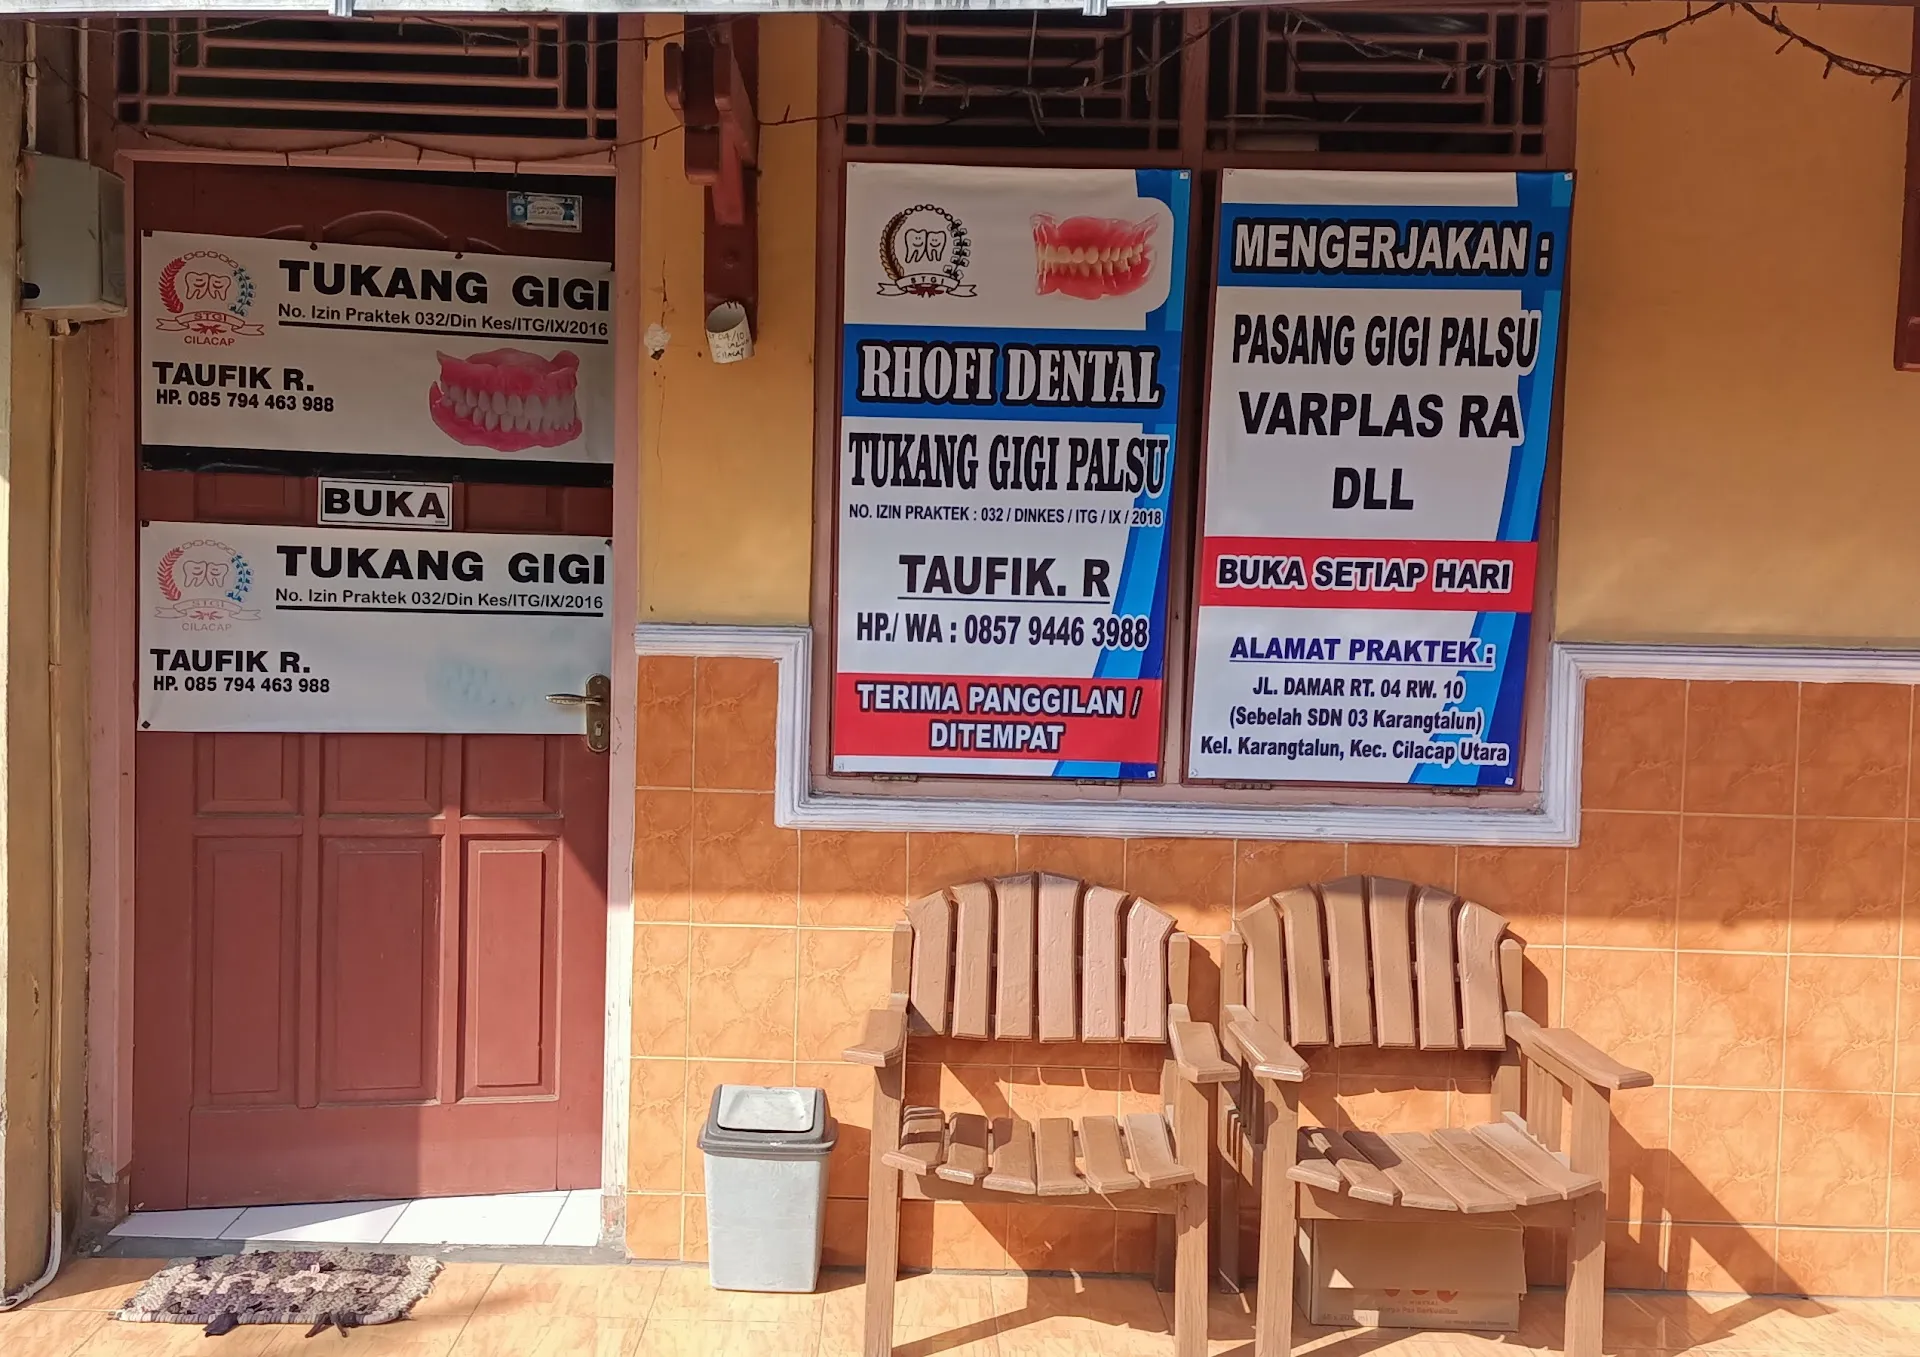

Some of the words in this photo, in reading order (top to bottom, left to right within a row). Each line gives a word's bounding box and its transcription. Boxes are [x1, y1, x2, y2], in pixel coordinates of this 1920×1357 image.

[1234, 223, 1528, 271] MENGERJAKAN
[1540, 237, 1550, 271] :
[279, 260, 487, 304] TUKANG
[512, 276, 609, 311] GIGI
[910, 275, 945, 285] STGI
[194, 312, 227, 322] STGI
[279, 303, 305, 317] No.
[312, 305, 340, 320] Izin
[346, 308, 410, 324] Praktek
[415, 312, 476, 328] 032/Din
[482, 316, 607, 335] Kes/ITG/IX/2016
[184, 335, 235, 346] CILACAP
[1233, 315, 1354, 365] PASANG
[1365, 316, 1430, 366] GIGI
[1439, 317, 1539, 368] PALSU
[152, 362, 272, 389] TAUFIK
[284, 368, 313, 391] R.
[860, 344, 994, 401] RHOFI
[1005, 349, 1160, 405] DENTAL
[157, 389, 181, 404] HP.
[188, 391, 220, 406] 085
[227, 393, 259, 408] 794
[265, 395, 296, 410] 463
[303, 396, 333, 412] 988
[1239, 392, 1443, 437] VARPLAS
[1460, 395, 1519, 438] RA
[849, 432, 978, 489] TUKANG
[989, 435, 1059, 491] GIGI
[1067, 435, 1169, 494] PALSU
[321, 486, 445, 519] BUKA
[1333, 468, 1413, 510] DLL
[850, 504, 872, 518] NO.
[877, 505, 901, 518] IZIN
[906, 506, 969, 520] PRAKTEK
[982, 508, 1003, 521] 032
[1015, 509, 1064, 522] DINKES
[1076, 510, 1097, 523] ITG
[1109, 510, 1121, 523] IX
[1132, 511, 1161, 524] 2018
[277, 546, 483, 581] TUKANG
[509, 553, 604, 584] GIGI
[899, 555, 1066, 596] TAUFIK.
[1083, 559, 1110, 597] R
[1218, 558, 1304, 587] BUKA
[1314, 560, 1425, 589] SETIAP
[1435, 562, 1510, 591] HARI
[276, 588, 302, 601] No.
[309, 589, 336, 602] Izin
[343, 590, 406, 604] Praktek
[412, 592, 472, 605] 032/Din
[479, 594, 602, 608] Kes/ITG/IX/2016
[181, 622, 233, 632] CILACAP
[906, 614, 942, 642] WA
[951, 623, 956, 643] :
[965, 615, 1021, 644] 0857
[1029, 616, 1084, 646] 9446
[1092, 617, 1148, 648] 3988
[150, 649, 268, 672] TAUFIK
[280, 652, 310, 673] R.
[1230, 637, 1340, 660] ALAMAT
[1349, 639, 1478, 663] PRAKTEK
[1486, 646, 1493, 664] :
[154, 676, 178, 691] HP.
[185, 677, 216, 691] 085
[224, 678, 255, 691] 794
[261, 678, 292, 692] 463
[299, 678, 329, 692] 988
[858, 682, 959, 712] TERIMA
[967, 685, 1124, 715] PANGGILAN
[1130, 687, 1142, 716] /
[1253, 677, 1277, 694] JL.
[1284, 678, 1344, 696] DAMAR
[1350, 679, 1374, 697] RT.
[1381, 680, 1400, 697] 04
[1407, 680, 1436, 698] RW.
[1444, 681, 1463, 699] 10
[1229, 706, 1302, 727] (Sebelah
[1307, 708, 1343, 727] SDN
[1347, 709, 1368, 728] 03
[1373, 710, 1484, 734] Karangtalun)
[930, 723, 1063, 751] DITEMPAT
[1201, 735, 1233, 756] Kel.
[1238, 737, 1344, 761] Karangtalun,
[1349, 740, 1387, 759] Kec.
[1392, 741, 1455, 765] Cilacap
[1460, 743, 1507, 763] Utara
